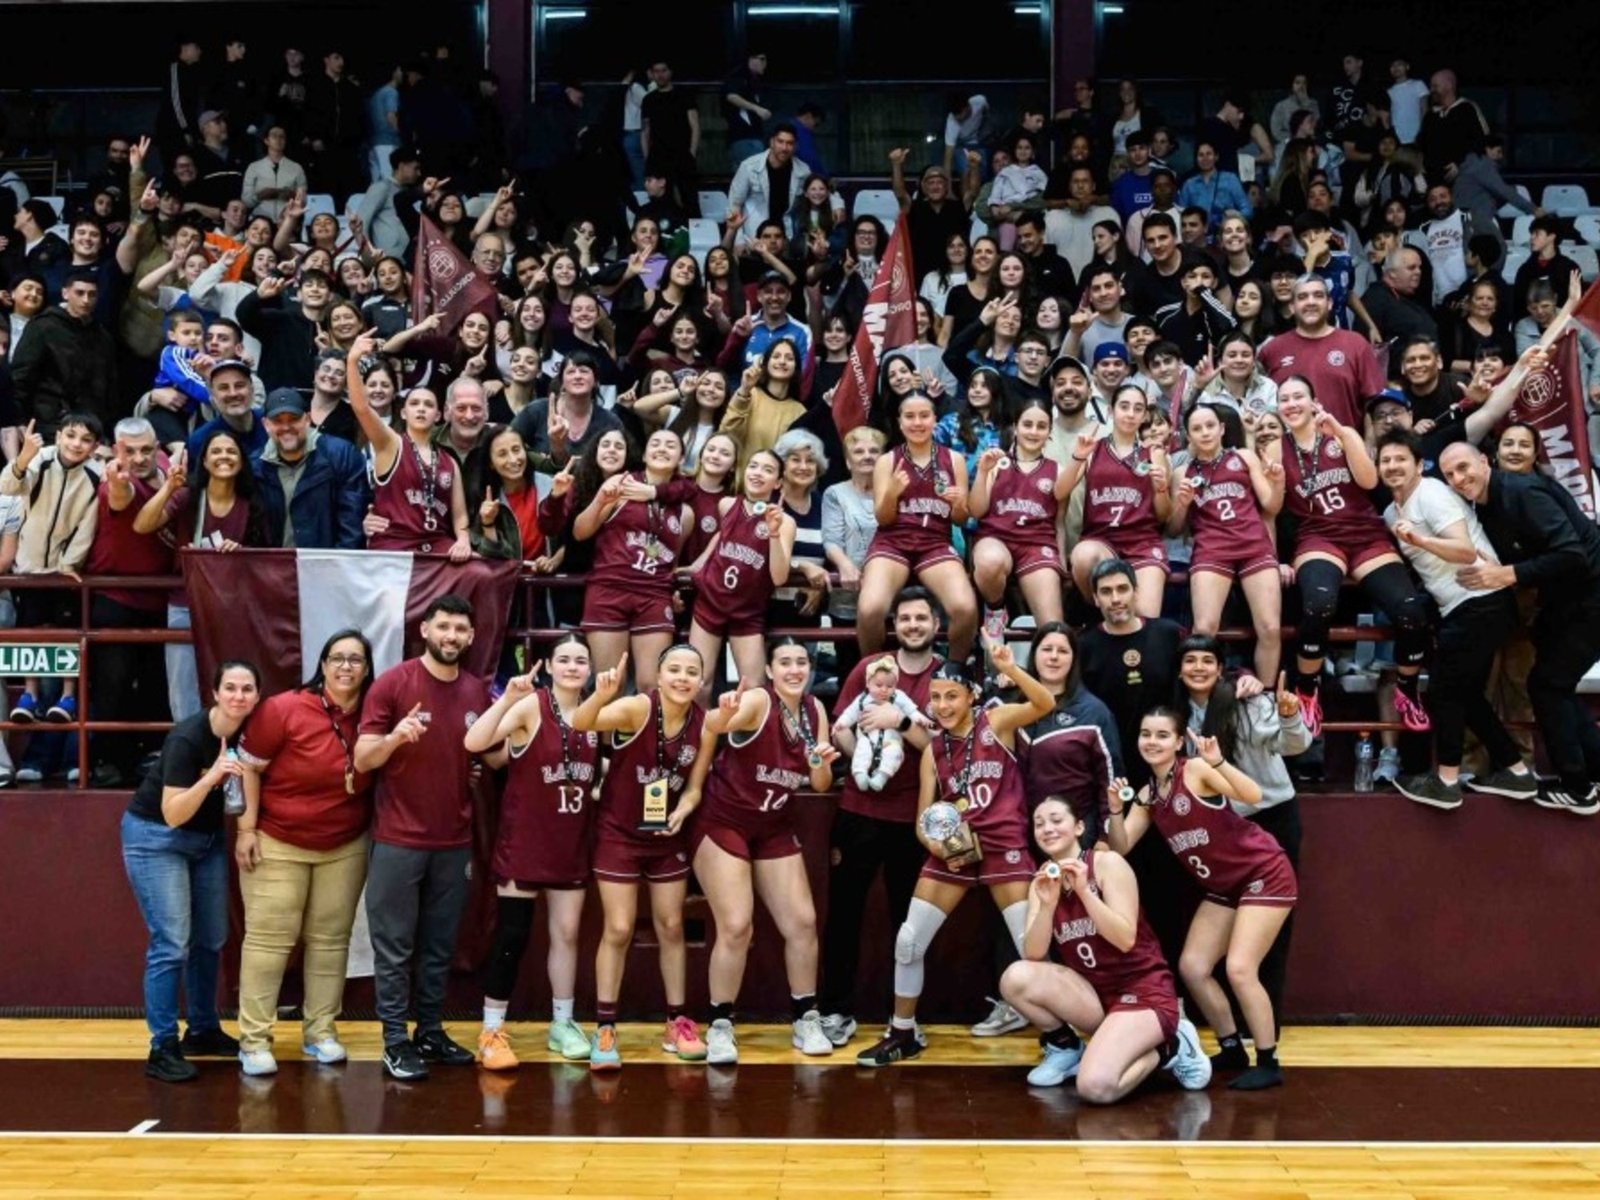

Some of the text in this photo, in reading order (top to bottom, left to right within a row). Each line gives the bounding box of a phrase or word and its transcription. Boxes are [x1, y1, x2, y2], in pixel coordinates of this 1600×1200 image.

[1217, 499, 1236, 521] 2
[1315, 487, 1345, 515] 15
[1109, 506, 1125, 527] 7
[631, 551, 659, 575] 12
[724, 565, 739, 590] 6
[558, 786, 584, 814] 13
[967, 784, 992, 809] 10
[1188, 855, 1211, 879] 3
[1054, 917, 1097, 945] LANU
[1077, 942, 1097, 969] 9
